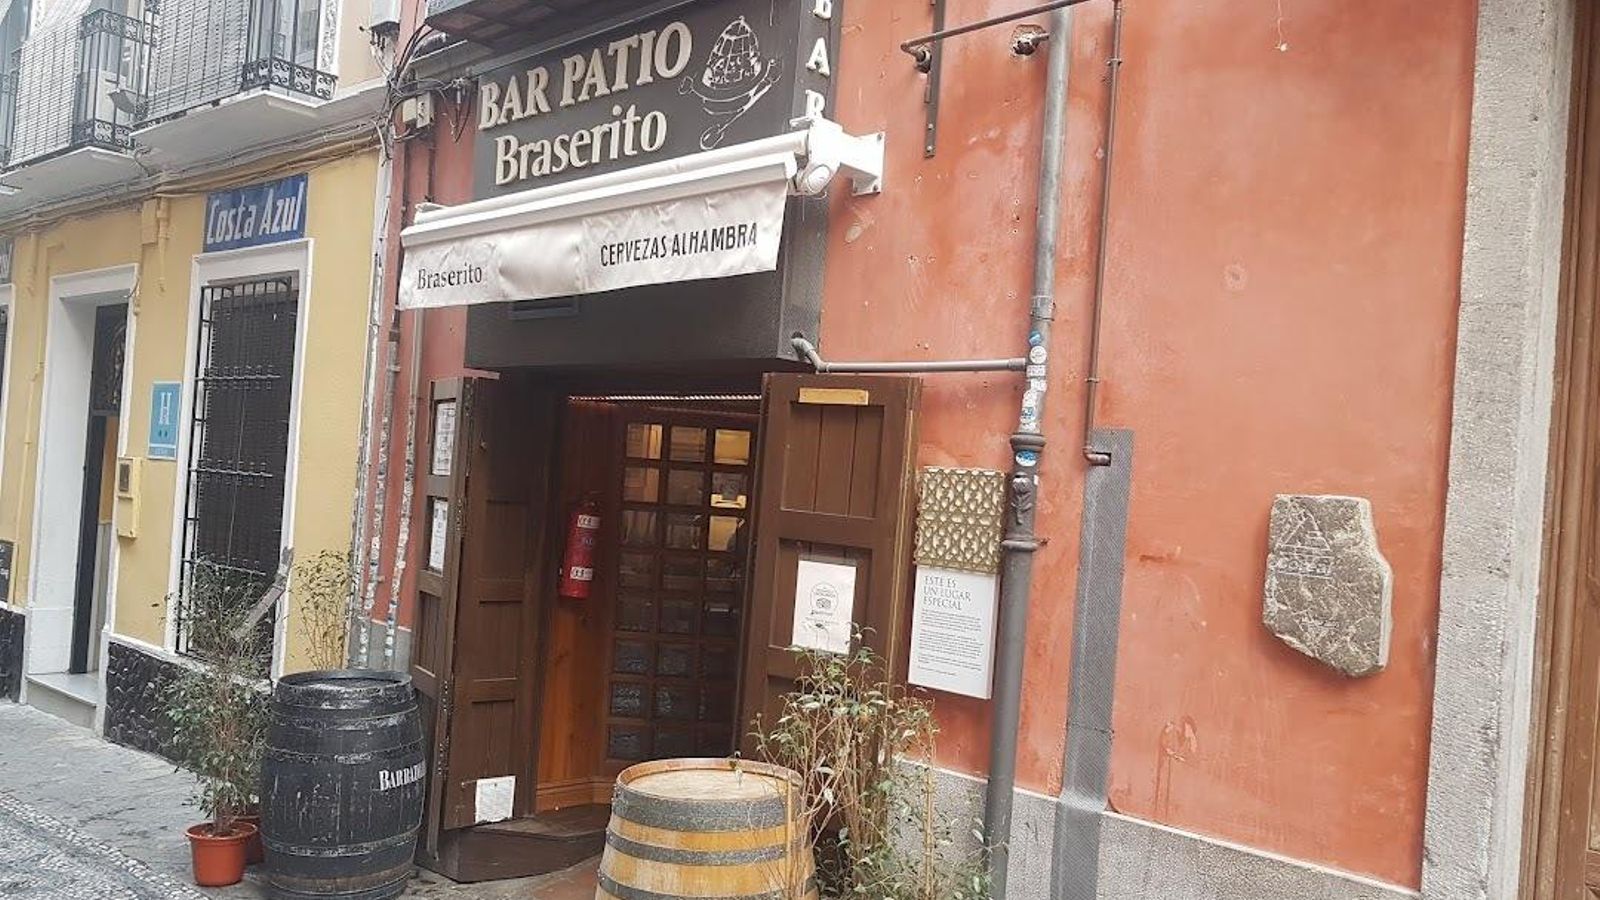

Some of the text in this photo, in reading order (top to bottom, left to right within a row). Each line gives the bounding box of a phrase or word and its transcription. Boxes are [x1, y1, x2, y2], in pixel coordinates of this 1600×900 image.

[478, 21, 692, 130] BAR PATIO
[805, 0, 832, 118] BAR
[495, 104, 667, 186] Braserito
[206, 181, 304, 244] Costa Azul
[600, 222, 757, 267] CERVEZAS ALHAMBRA
[417, 262, 482, 290] Braserito
[922, 596, 962, 610] ESPECIAL
[923, 585, 971, 602] UN LUGAR
[924, 575, 956, 588] ESTE ES
